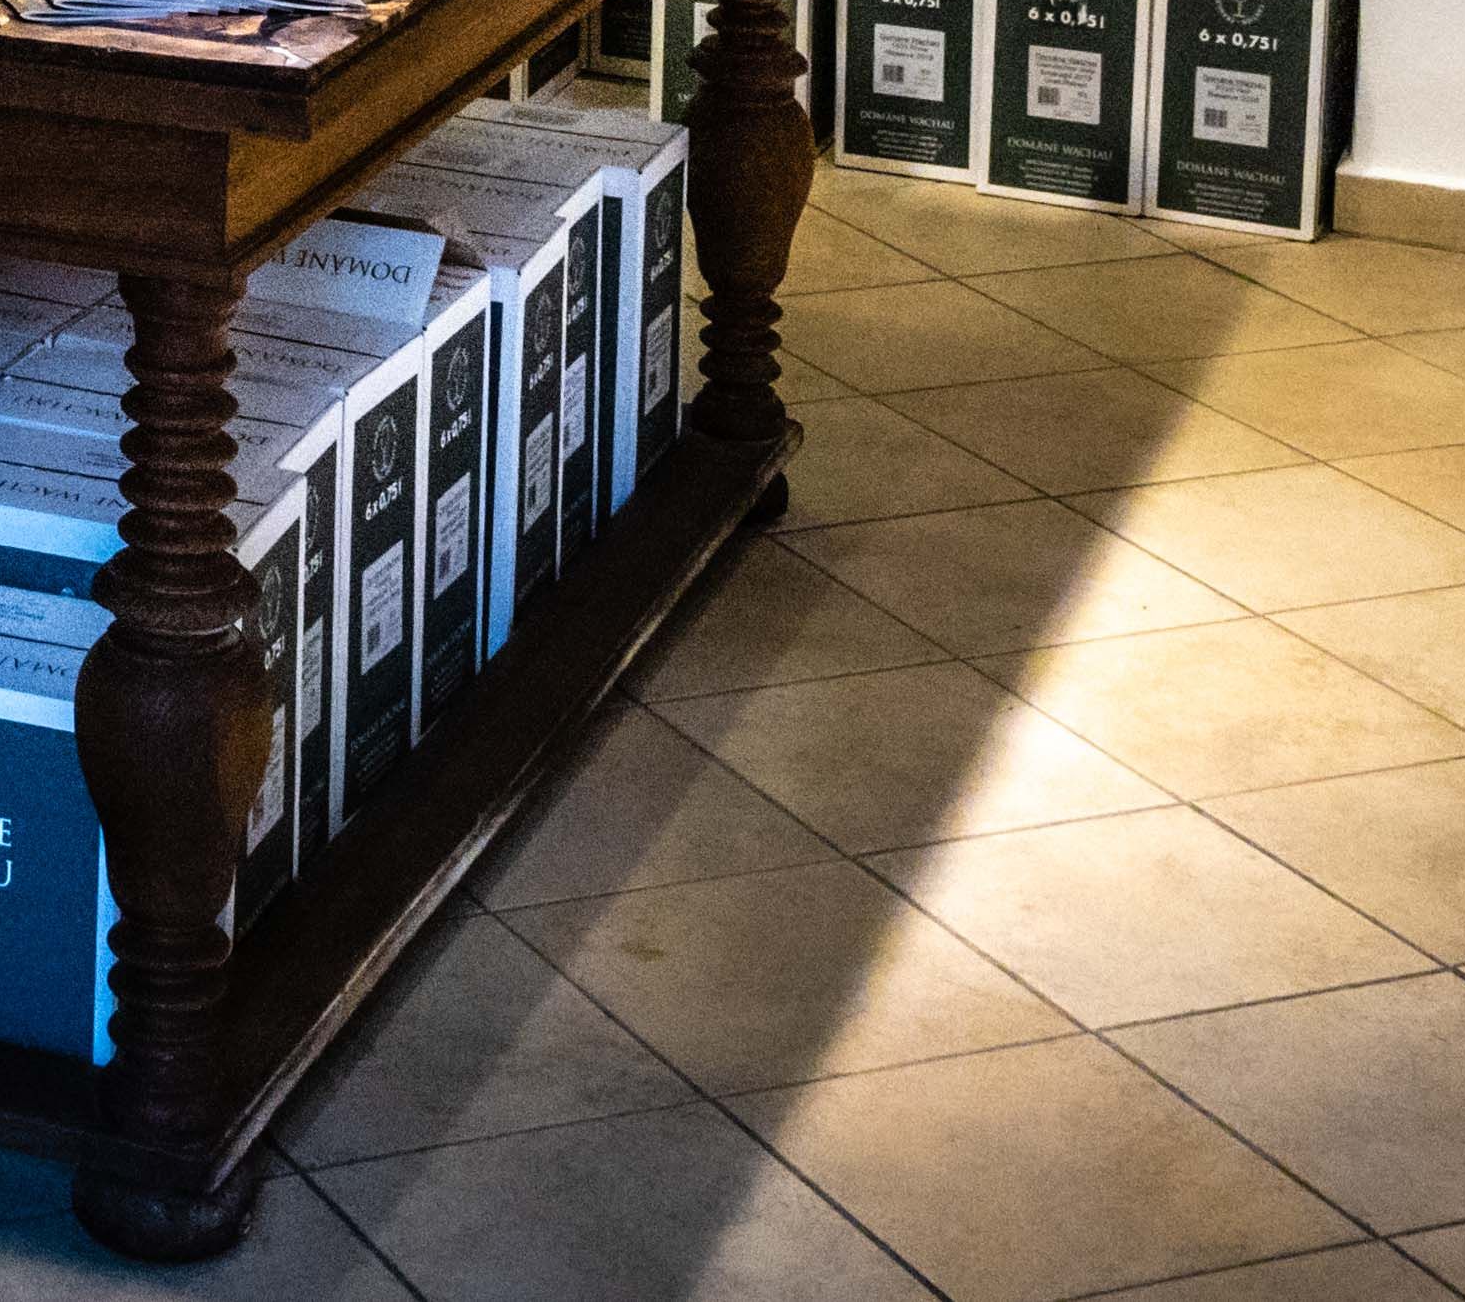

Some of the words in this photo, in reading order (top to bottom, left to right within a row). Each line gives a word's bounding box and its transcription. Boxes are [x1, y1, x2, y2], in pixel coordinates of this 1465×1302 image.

[1027, 7, 1039, 21] 6
[1044, 12, 1055, 23] x
[1198, 28, 1210, 42] 6
[1215, 34, 1227, 45] x
